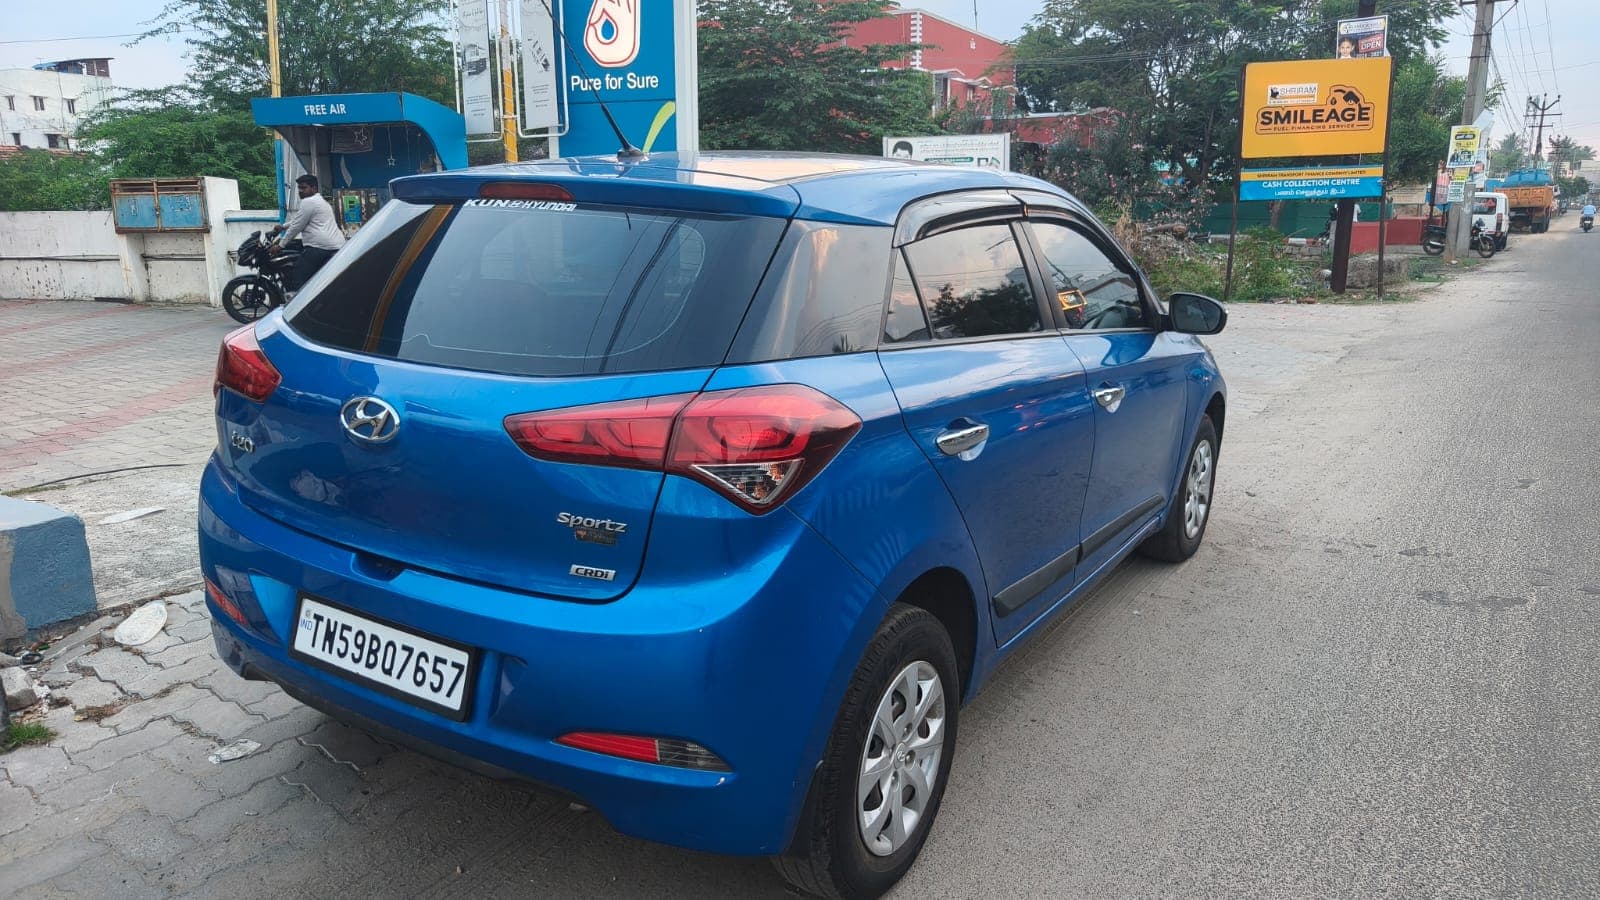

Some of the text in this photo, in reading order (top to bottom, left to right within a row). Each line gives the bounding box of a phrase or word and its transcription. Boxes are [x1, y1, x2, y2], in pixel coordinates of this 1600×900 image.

[1362, 39, 1381, 49] OPEN
[571, 72, 659, 91] Pure for Sure
[1280, 86, 1316, 95] SHRIRAM
[304, 103, 347, 116] FREE AIR
[1260, 106, 1371, 126] SMILEAGE
[463, 198, 577, 212] KUN HYUNDAI
[231, 430, 253, 453] i20
[556, 511, 628, 533] Sportz
[575, 567, 609, 579] CRDi
[300, 618, 313, 632] IND
[311, 613, 466, 699] TN59BQ7657
